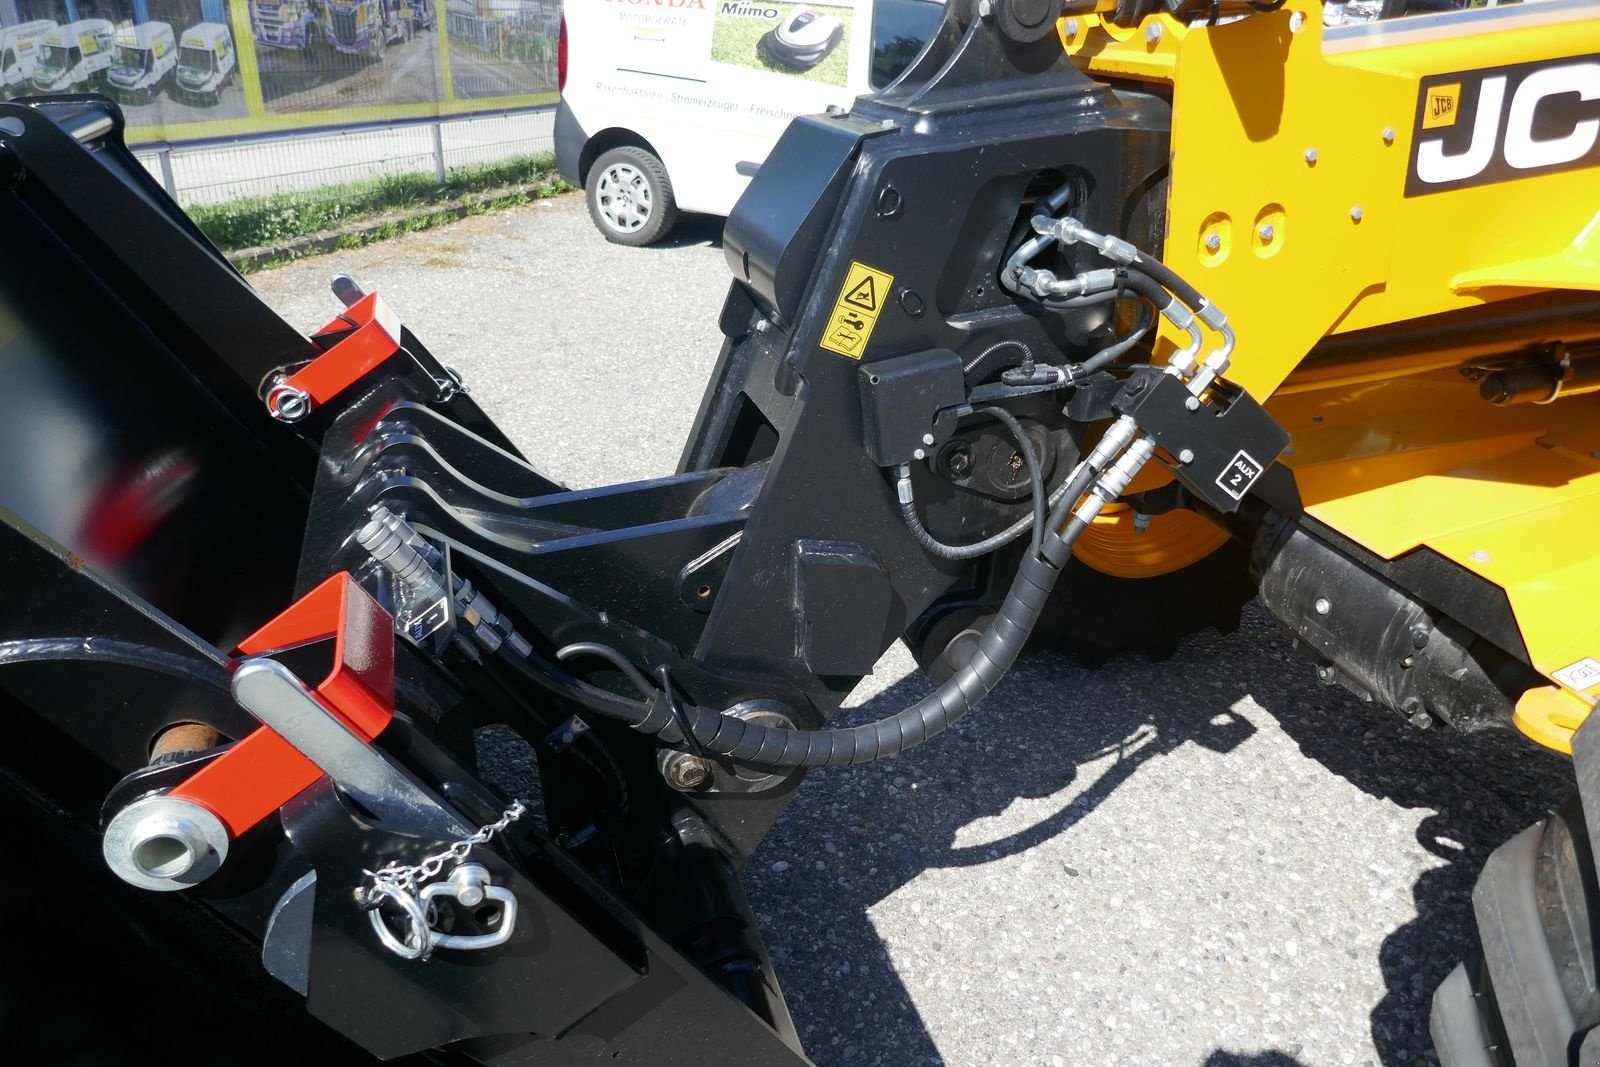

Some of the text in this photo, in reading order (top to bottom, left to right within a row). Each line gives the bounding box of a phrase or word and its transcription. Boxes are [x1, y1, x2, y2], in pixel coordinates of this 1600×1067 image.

[721, 1, 778, 18] Miimo
[596, 81, 663, 99] Rasentraktoren
[671, 92, 739, 112] Stromerzeuger
[1434, 98, 1452, 116] JCB
[1234, 460, 1255, 479] AUX
[1229, 473, 1242, 487] 2
